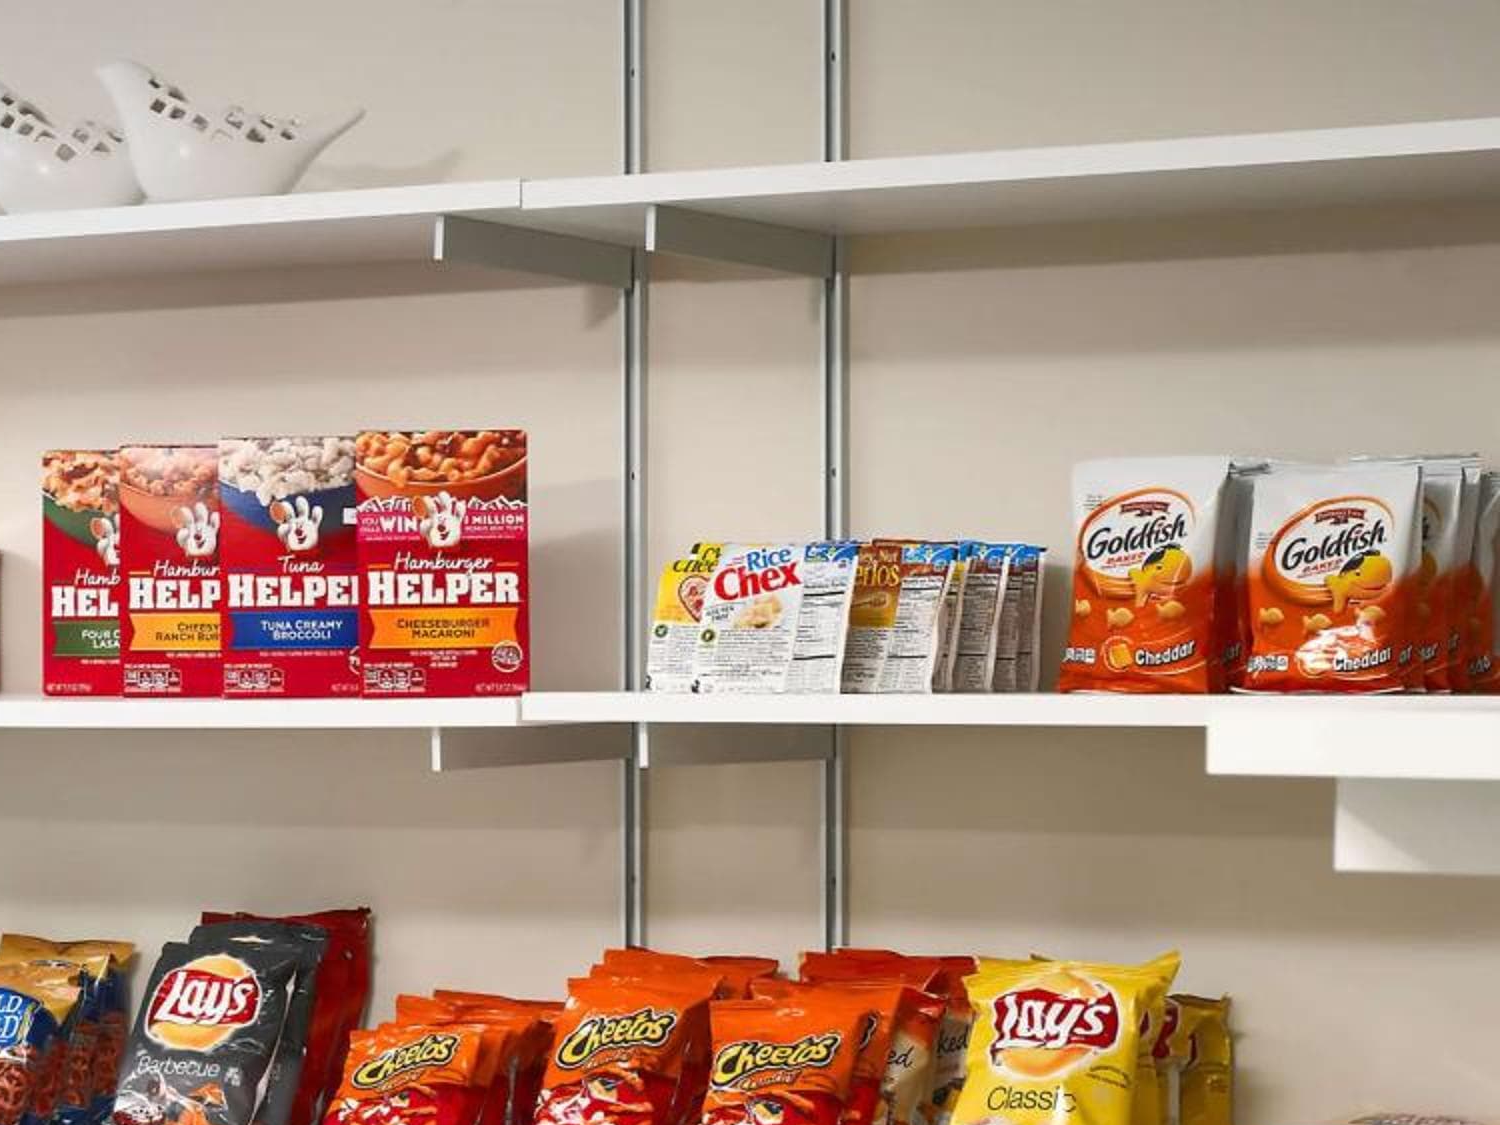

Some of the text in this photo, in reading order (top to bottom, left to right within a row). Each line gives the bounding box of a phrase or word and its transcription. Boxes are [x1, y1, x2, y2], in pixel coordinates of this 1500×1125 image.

[380, 515, 418, 532] WIN
[471, 514, 524, 525] MILLION
[1087, 513, 1185, 560] Goldfish
[1281, 519, 1384, 571] Goldfish
[153, 560, 220, 577] Hambur
[277, 554, 325, 573] Tuna
[394, 550, 494, 578] Hamburger
[746, 548, 792, 571] Rice
[367, 571, 519, 604] HELPER
[714, 561, 802, 601] Chex
[856, 563, 900, 587] erios
[52, 585, 119, 617] HEL
[129, 577, 221, 609] HELP
[81, 629, 111, 640] FOUR
[260, 619, 343, 631] TUNA CREAMY
[273, 630, 332, 640] BROCCOLI
[396, 618, 490, 629] CHEESEBURGER
[412, 629, 475, 639] MACARONI
[156, 632, 194, 641] RANCH
[1135, 640, 1195, 666] Cheddar
[1332, 647, 1391, 672] Cheddar
[154, 970, 254, 1025] Lay's
[994, 990, 1113, 1049] Lay's
[557, 1008, 676, 1068] Cheetos
[136, 1055, 221, 1078] Barbecue
[353, 1034, 460, 1088] Cheetos
[711, 1033, 841, 1088] Cheetos
[987, 1085, 1078, 1114] Classic
